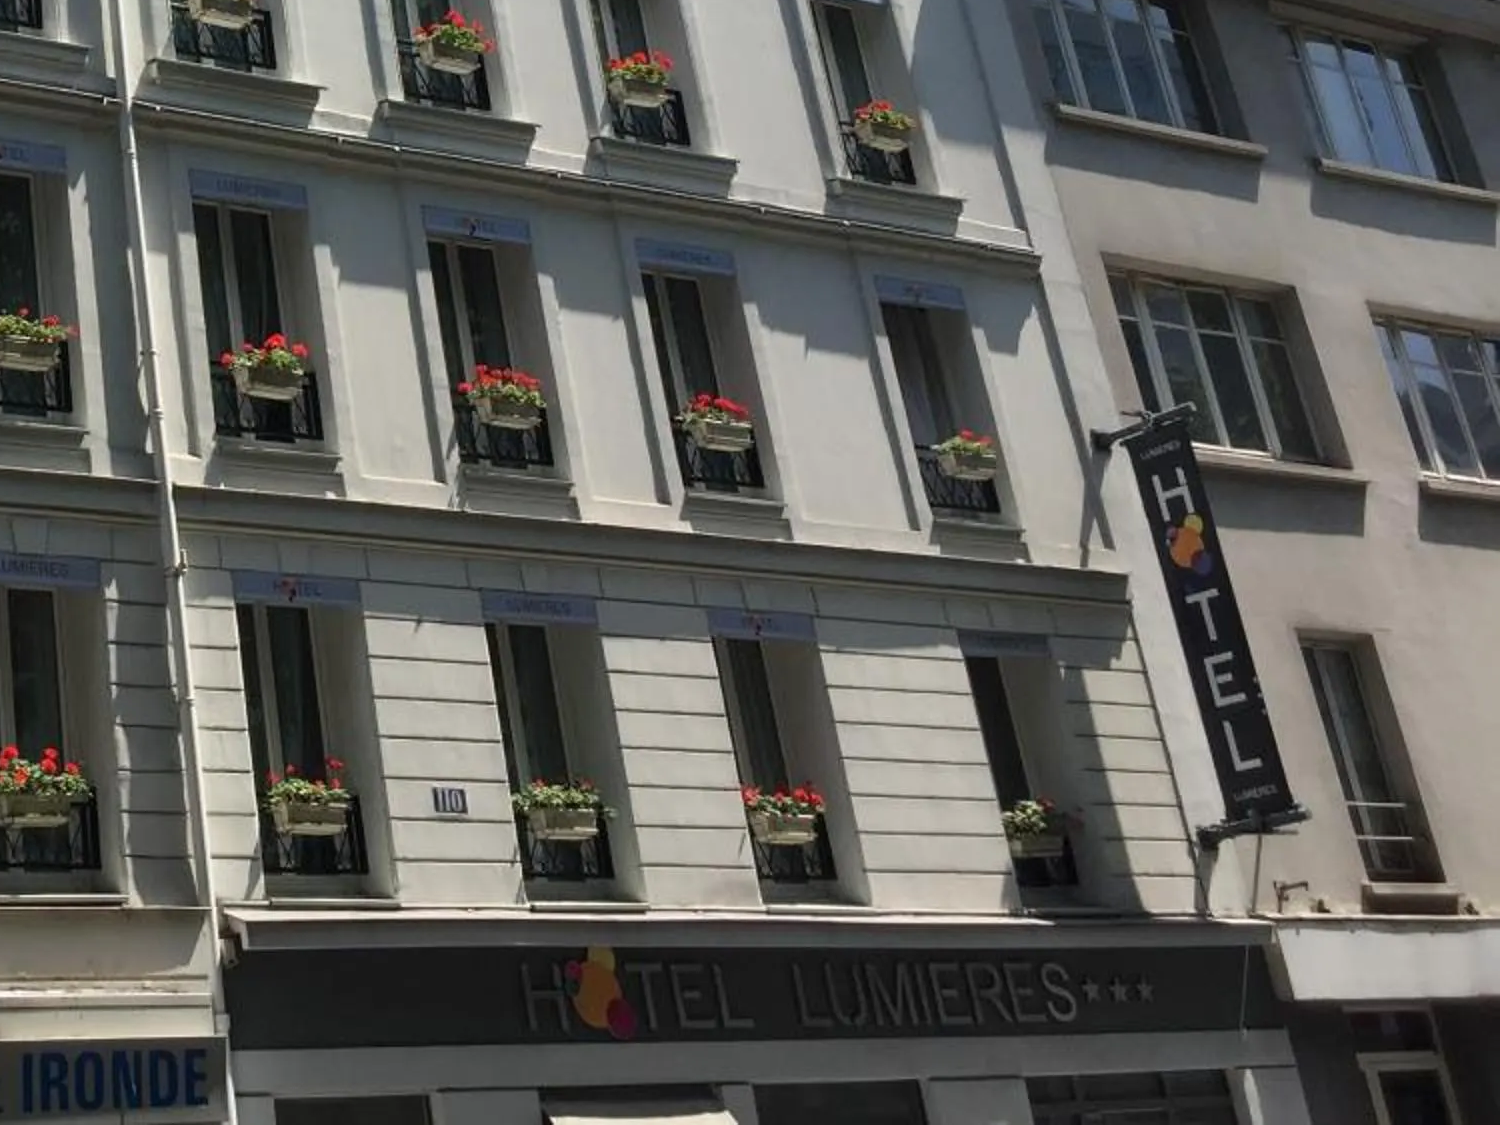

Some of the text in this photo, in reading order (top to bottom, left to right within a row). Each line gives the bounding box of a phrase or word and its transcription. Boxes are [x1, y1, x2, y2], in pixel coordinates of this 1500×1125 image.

[1151, 466, 1263, 772] HOTEL
[520, 945, 1078, 1040] HOTEL LUMIERES
[20, 1047, 209, 1113] IRONDE
